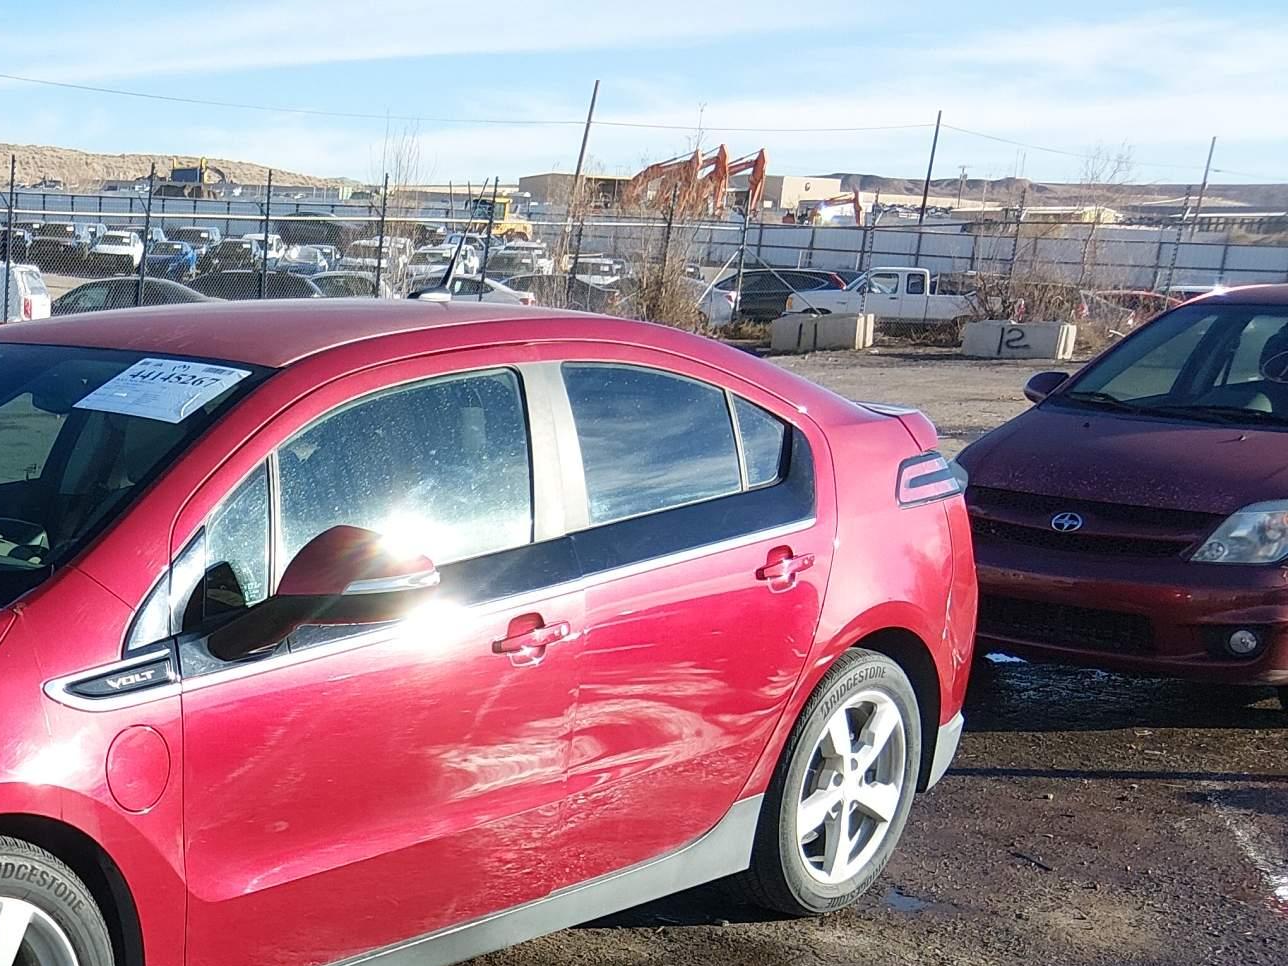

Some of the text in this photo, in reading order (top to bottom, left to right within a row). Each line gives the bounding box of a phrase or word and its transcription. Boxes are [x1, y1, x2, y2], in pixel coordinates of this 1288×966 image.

[997, 327, 1031, 355] 12
[129, 369, 220, 388] 44145267
[105, 670, 155, 689] VOLT
[820, 665, 887, 721] BRIDGESTONE
